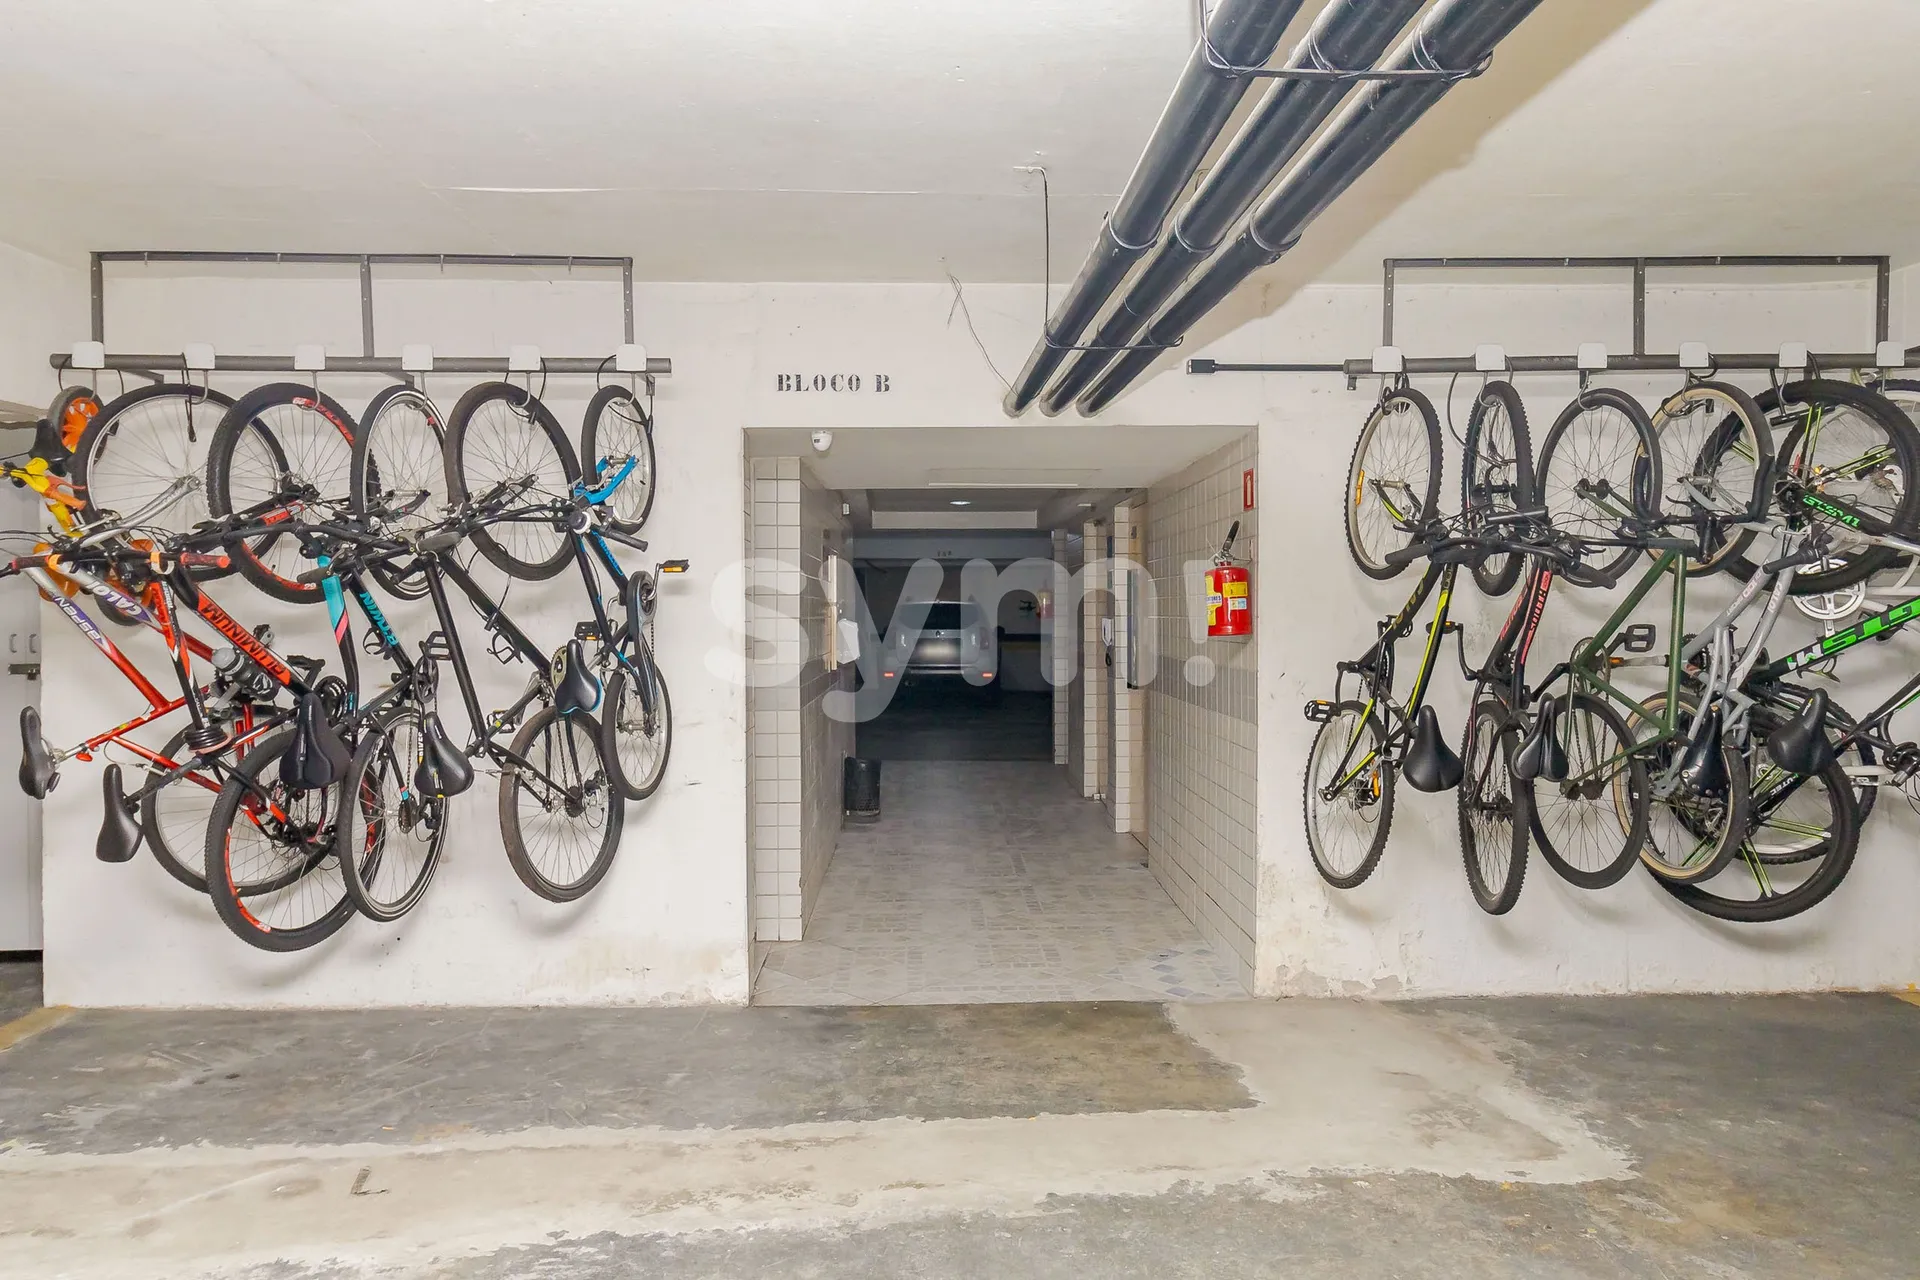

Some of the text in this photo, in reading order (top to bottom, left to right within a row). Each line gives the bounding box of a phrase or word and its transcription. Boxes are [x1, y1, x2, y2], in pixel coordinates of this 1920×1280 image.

[776, 373, 891, 393] BLOCO B
[86, 580, 142, 616] CALOI
